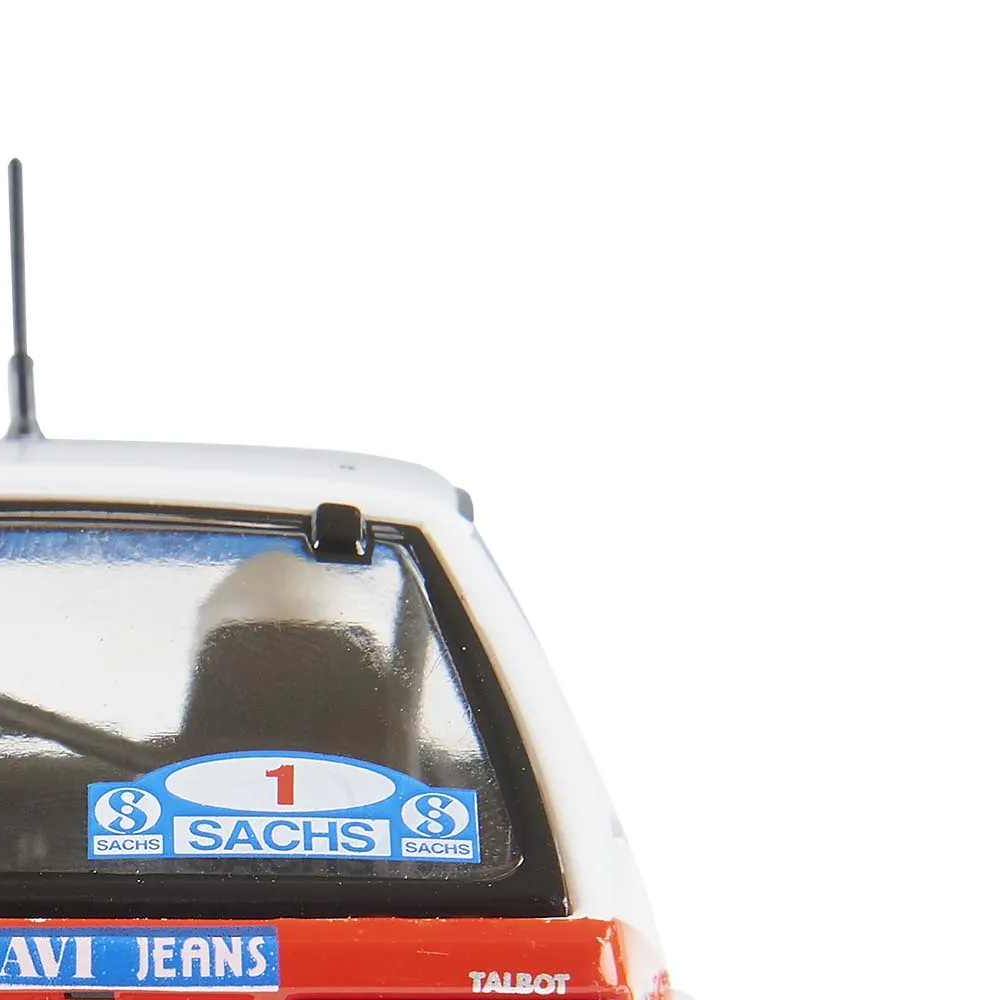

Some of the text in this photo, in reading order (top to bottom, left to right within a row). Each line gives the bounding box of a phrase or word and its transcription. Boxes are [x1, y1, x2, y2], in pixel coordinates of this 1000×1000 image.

[265, 764, 295, 805] 1
[96, 838, 161, 852] SACHS
[188, 819, 376, 853] SACHS
[405, 841, 471, 856] SACHS
[136, 936, 266, 980] JEANS
[468, 971, 571, 995] TALBOT
